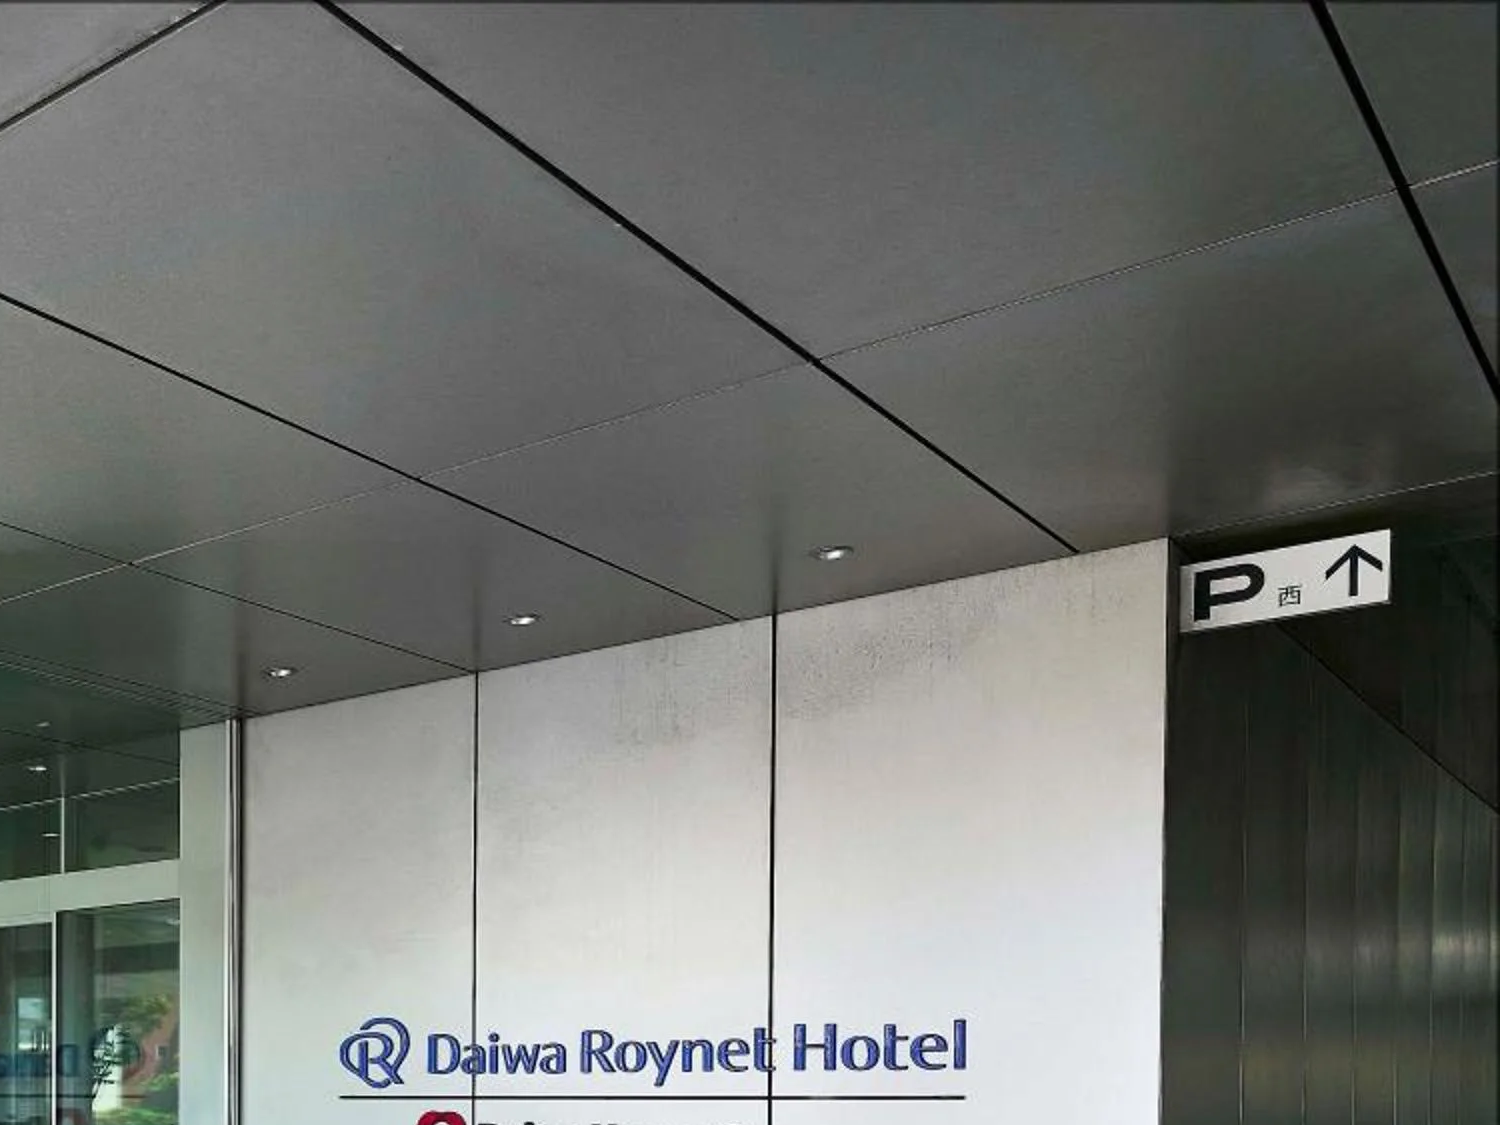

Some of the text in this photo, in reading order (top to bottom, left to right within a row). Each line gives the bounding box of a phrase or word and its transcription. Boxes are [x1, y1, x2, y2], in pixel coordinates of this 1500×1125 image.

[1194, 563, 1303, 622] P 西
[425, 1034, 567, 1074] Daiwa
[579, 1027, 777, 1087] Roynet
[793, 1019, 967, 1070] Hotel
